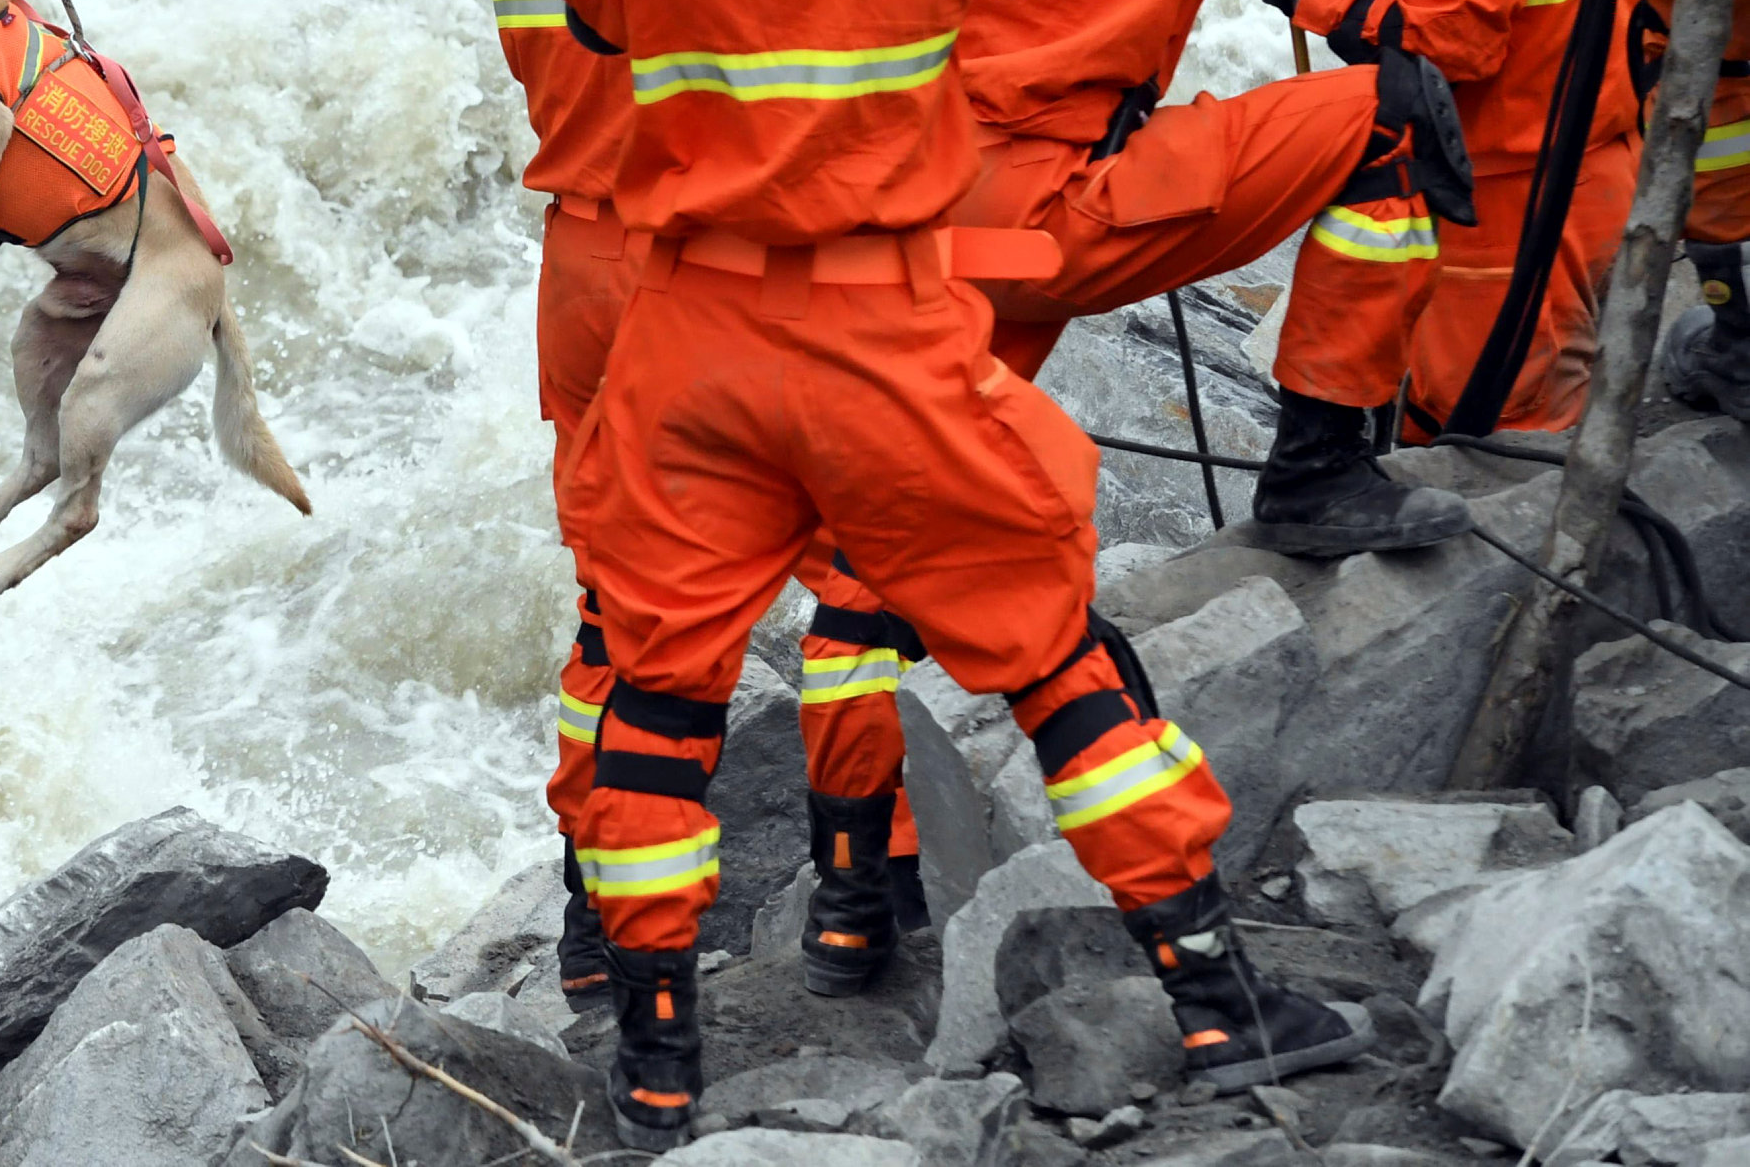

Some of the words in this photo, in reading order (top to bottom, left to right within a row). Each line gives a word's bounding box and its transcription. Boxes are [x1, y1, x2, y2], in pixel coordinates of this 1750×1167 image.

[21, 107, 84, 162] RESCUE
[82, 150, 111, 184] DOG
[36, 80, 129, 165] 消防搜救
